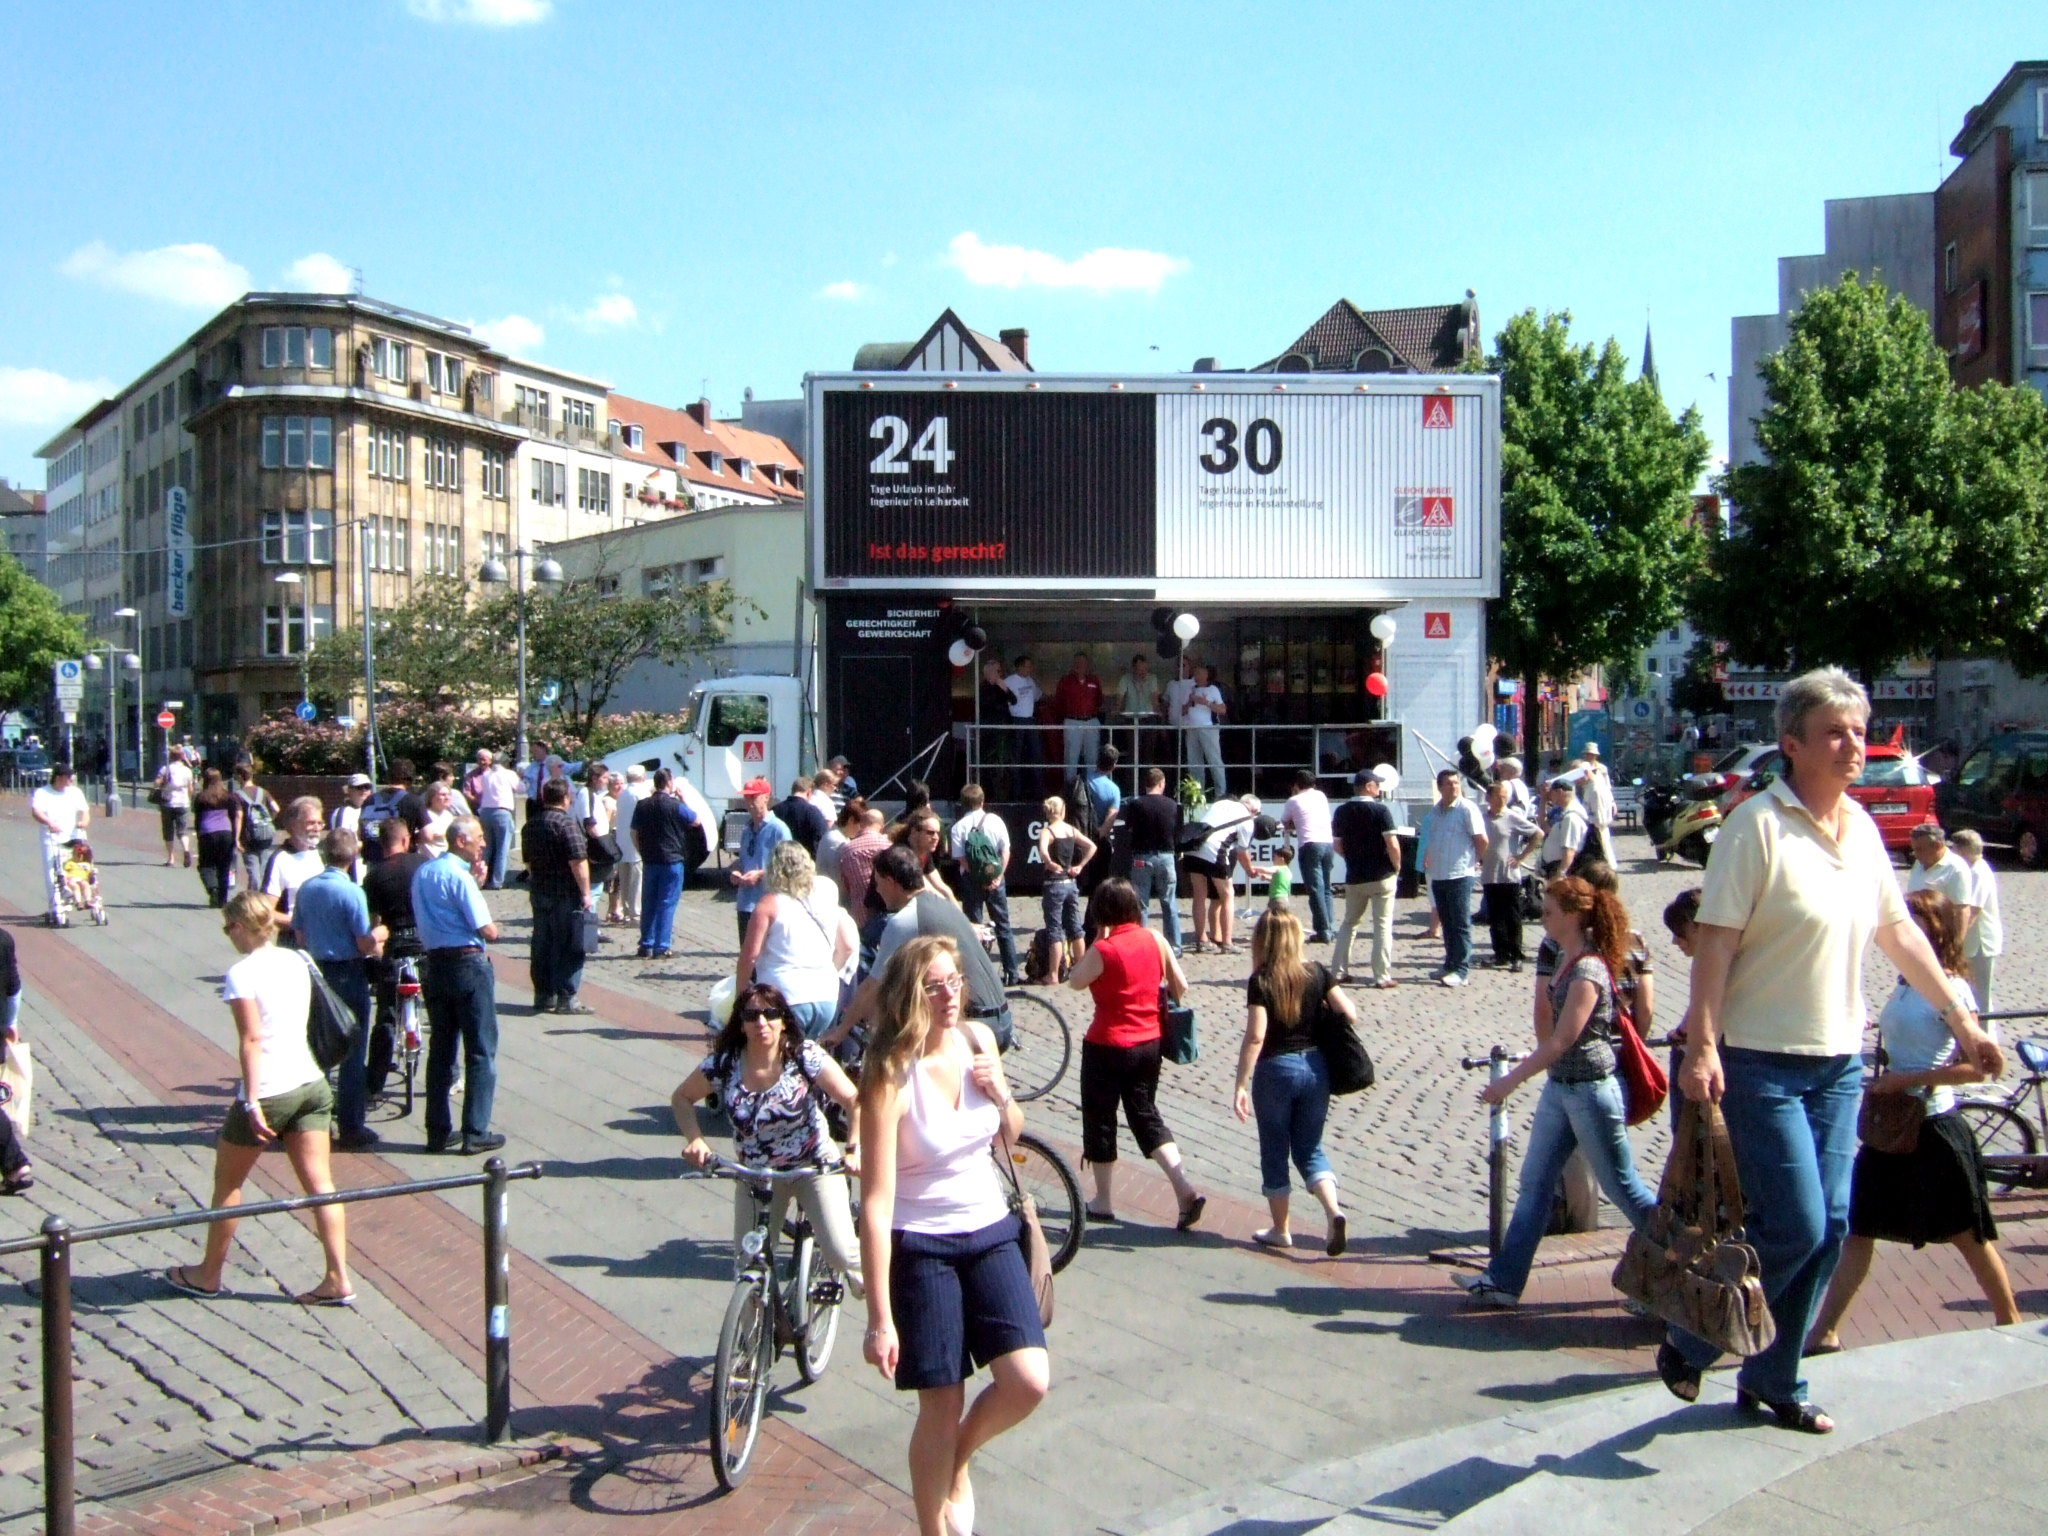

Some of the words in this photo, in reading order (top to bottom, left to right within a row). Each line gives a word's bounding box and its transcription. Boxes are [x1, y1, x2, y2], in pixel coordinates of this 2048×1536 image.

[869, 415, 956, 474] 24
[1200, 417, 1283, 475] 30
[870, 484, 892, 496] Tage
[892, 484, 923, 494] Urlaub
[924, 484, 936, 494] im
[937, 484, 957, 495] Jahr
[1199, 485, 1221, 497] Tage
[1222, 485, 1254, 496] Urlaub
[1255, 485, 1268, 496] im
[1269, 485, 1288, 497] Jahr
[870, 497, 912, 508] Ingenieur
[913, 497, 923, 506] in
[870, 543, 892, 559] Ist
[897, 543, 927, 559] das
[931, 542, 1005, 563] gerecht?
[171, 549, 184, 612] becker
[886, 609, 941, 618] SICHERHEIT
[845, 619, 917, 628] GERECHTIGKEIT
[857, 629, 932, 638] GEWERKSCHAFT
